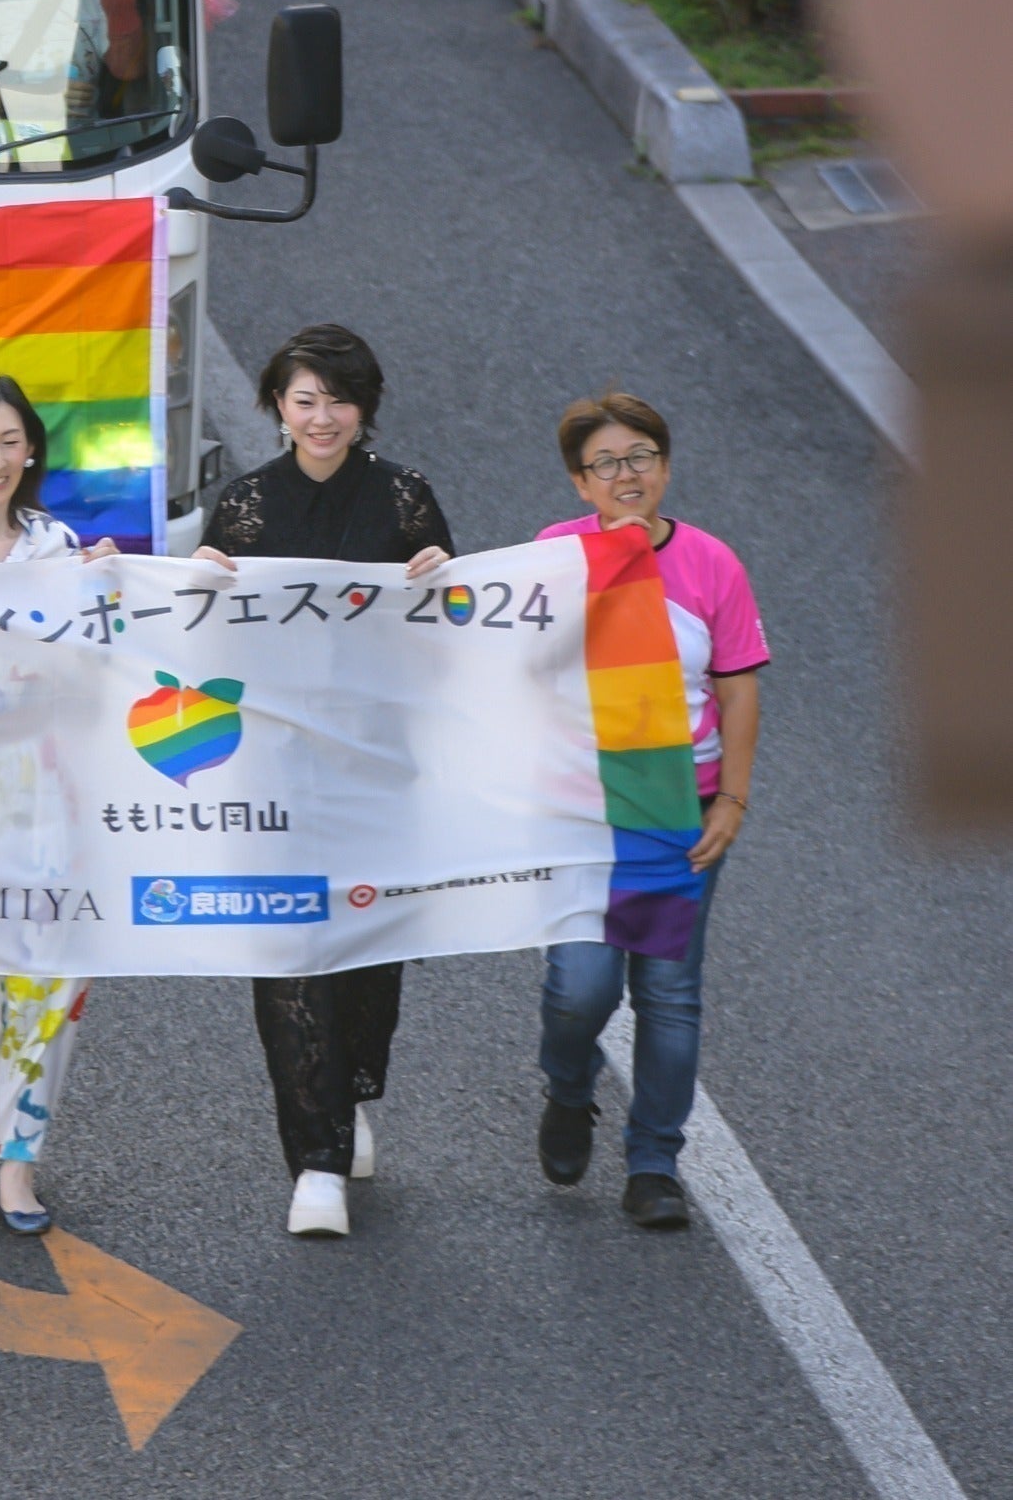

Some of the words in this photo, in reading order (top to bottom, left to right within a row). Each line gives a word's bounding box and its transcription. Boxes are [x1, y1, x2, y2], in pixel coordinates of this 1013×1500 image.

[404, 581, 555, 632] 2024
[102, 801, 290, 833] ももにじ岡山
[190, 891, 323, 916] 良和ハウス
